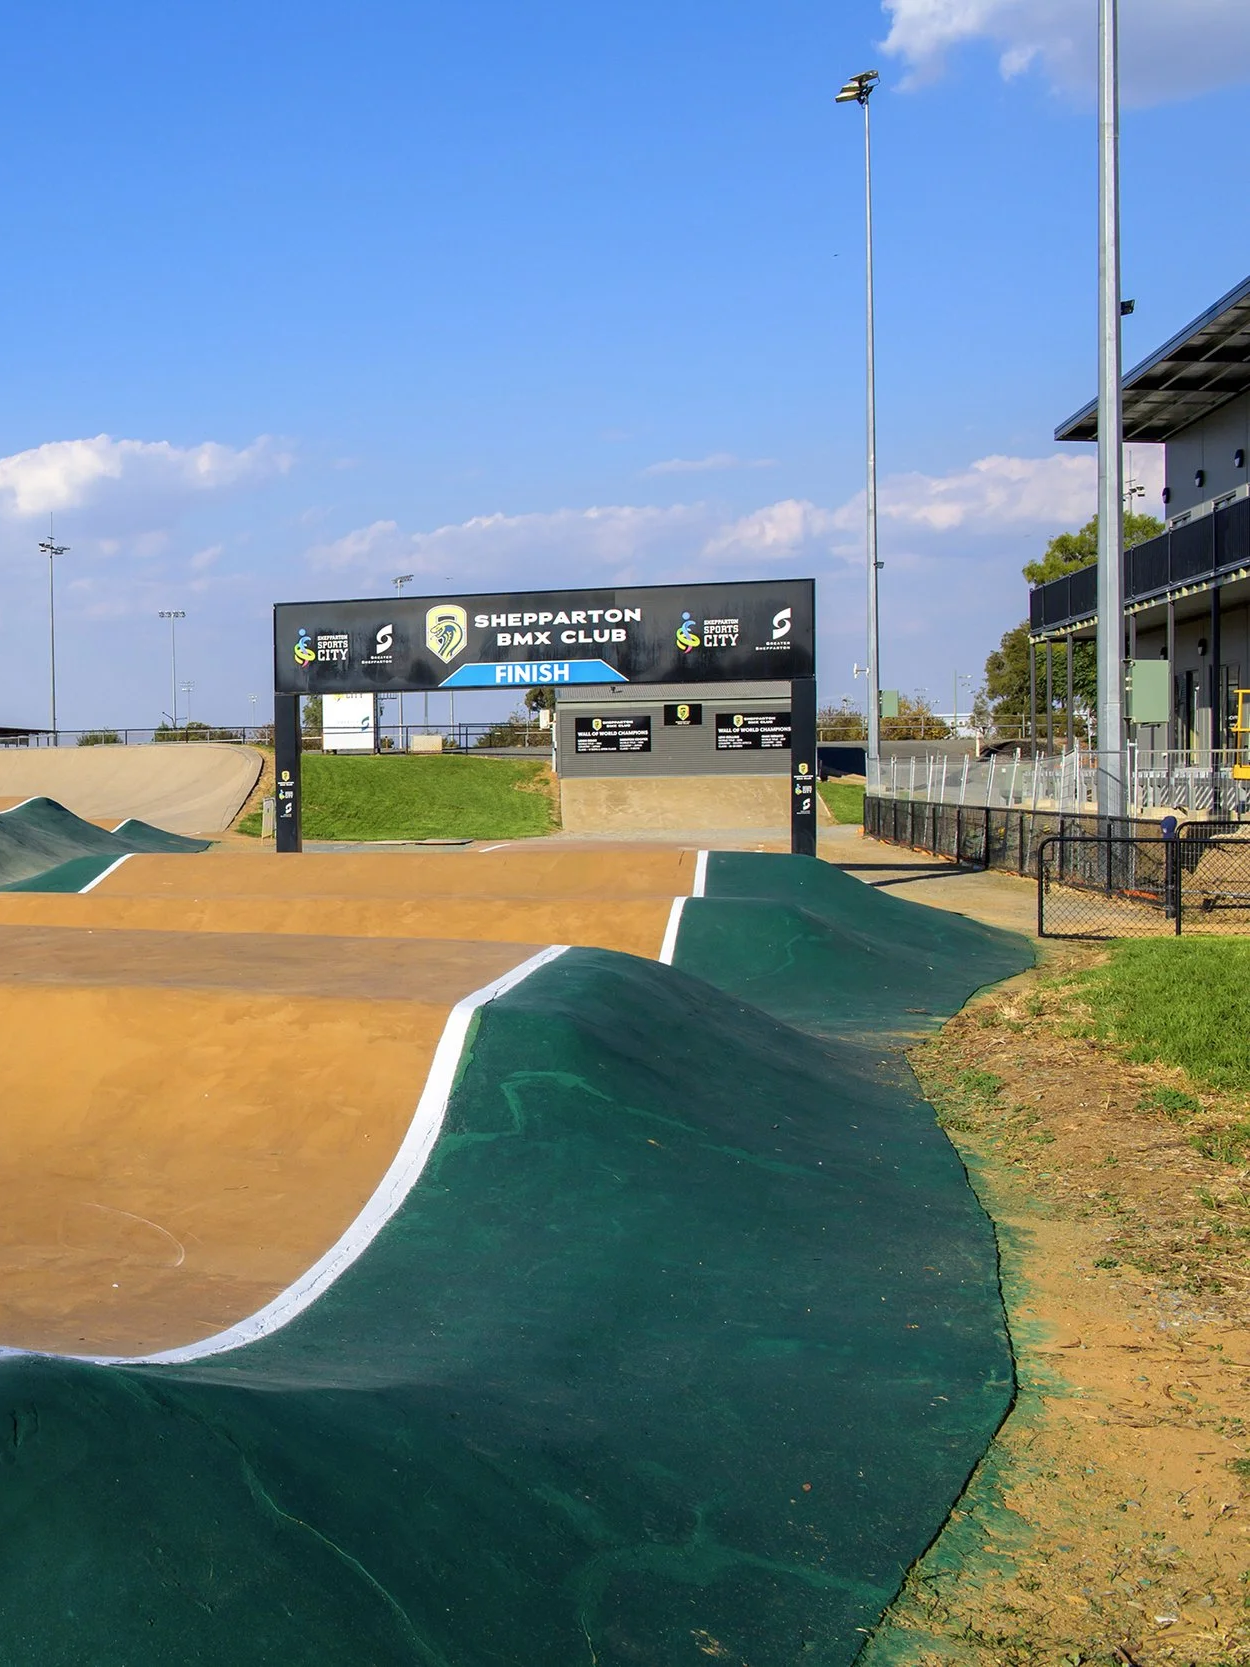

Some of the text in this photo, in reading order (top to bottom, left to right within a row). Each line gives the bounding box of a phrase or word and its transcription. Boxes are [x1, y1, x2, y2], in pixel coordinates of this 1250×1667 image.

[474, 608, 642, 628] SHEPPARTON
[704, 625, 739, 634] SPORTS
[497, 629, 626, 646] BMX CLUB
[704, 634, 739, 647] CITY
[318, 640, 348, 649] SPORTS
[318, 649, 348, 662] CITY
[495, 663, 570, 684] FINISH
